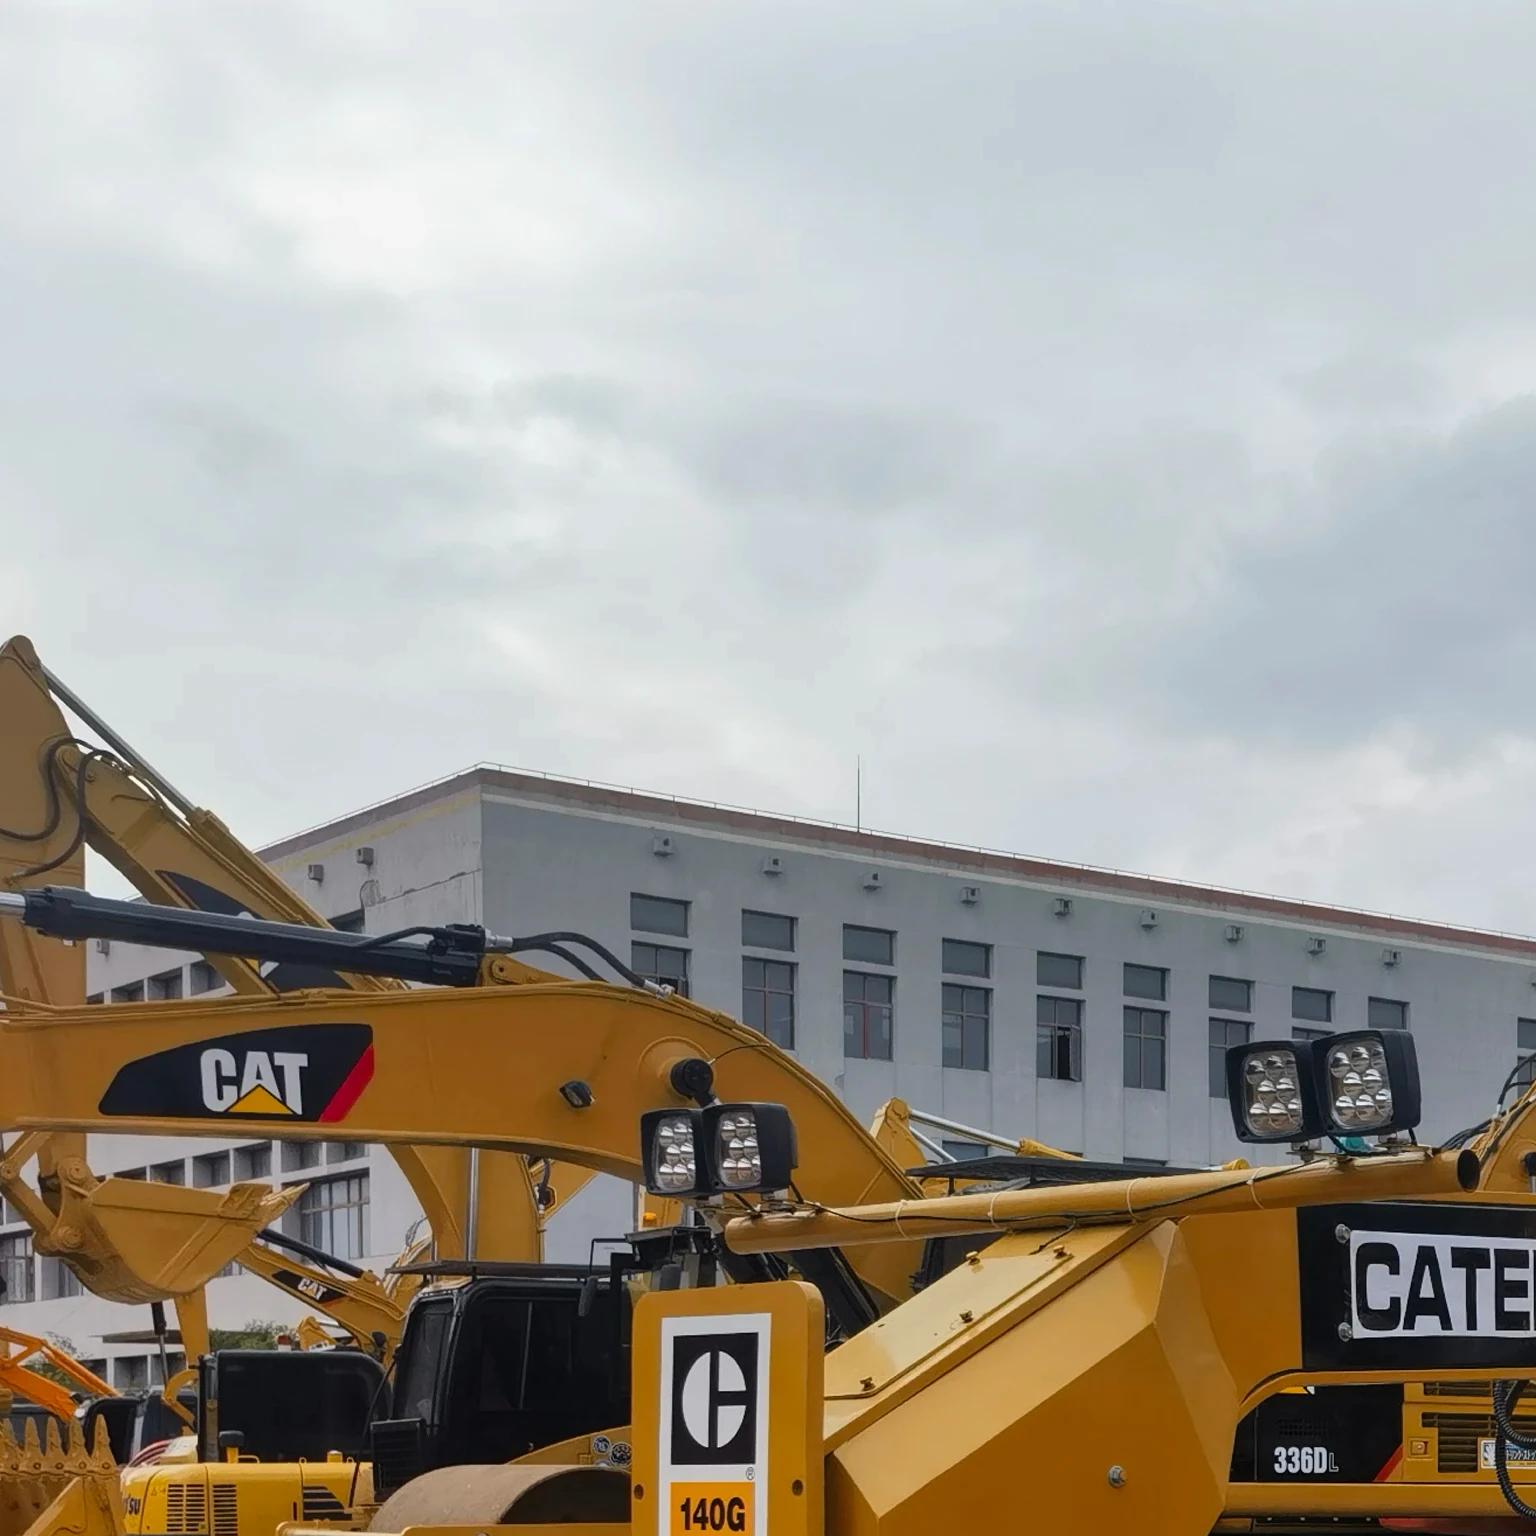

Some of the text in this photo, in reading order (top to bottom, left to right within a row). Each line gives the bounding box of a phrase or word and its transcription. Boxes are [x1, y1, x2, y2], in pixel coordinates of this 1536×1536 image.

[200, 1048, 308, 1116] CAT
[297, 1277, 328, 1301] CAT
[680, 1496, 746, 1532] 140G
